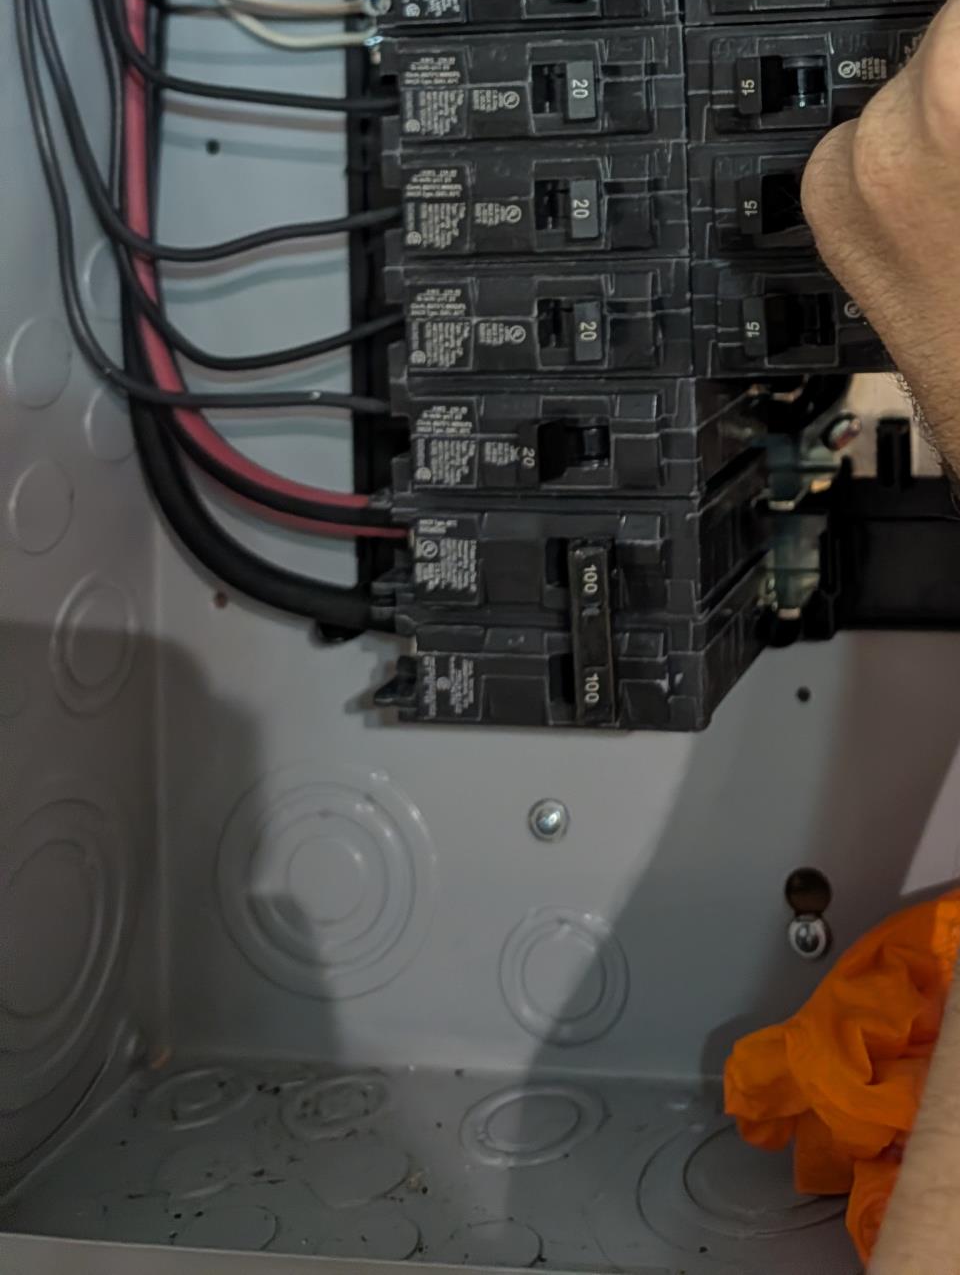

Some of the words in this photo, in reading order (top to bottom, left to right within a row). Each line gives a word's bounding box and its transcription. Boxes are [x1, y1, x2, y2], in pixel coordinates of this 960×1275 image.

[571, 78, 589, 100] 20
[741, 78, 755, 96] 15
[572, 198, 590, 219] 20
[744, 199, 758, 217] 15
[579, 321, 597, 342] 20
[746, 320, 760, 338] 15
[521, 446, 536, 469] 20
[582, 564, 599, 595] 100
[584, 671, 600, 705] 100
